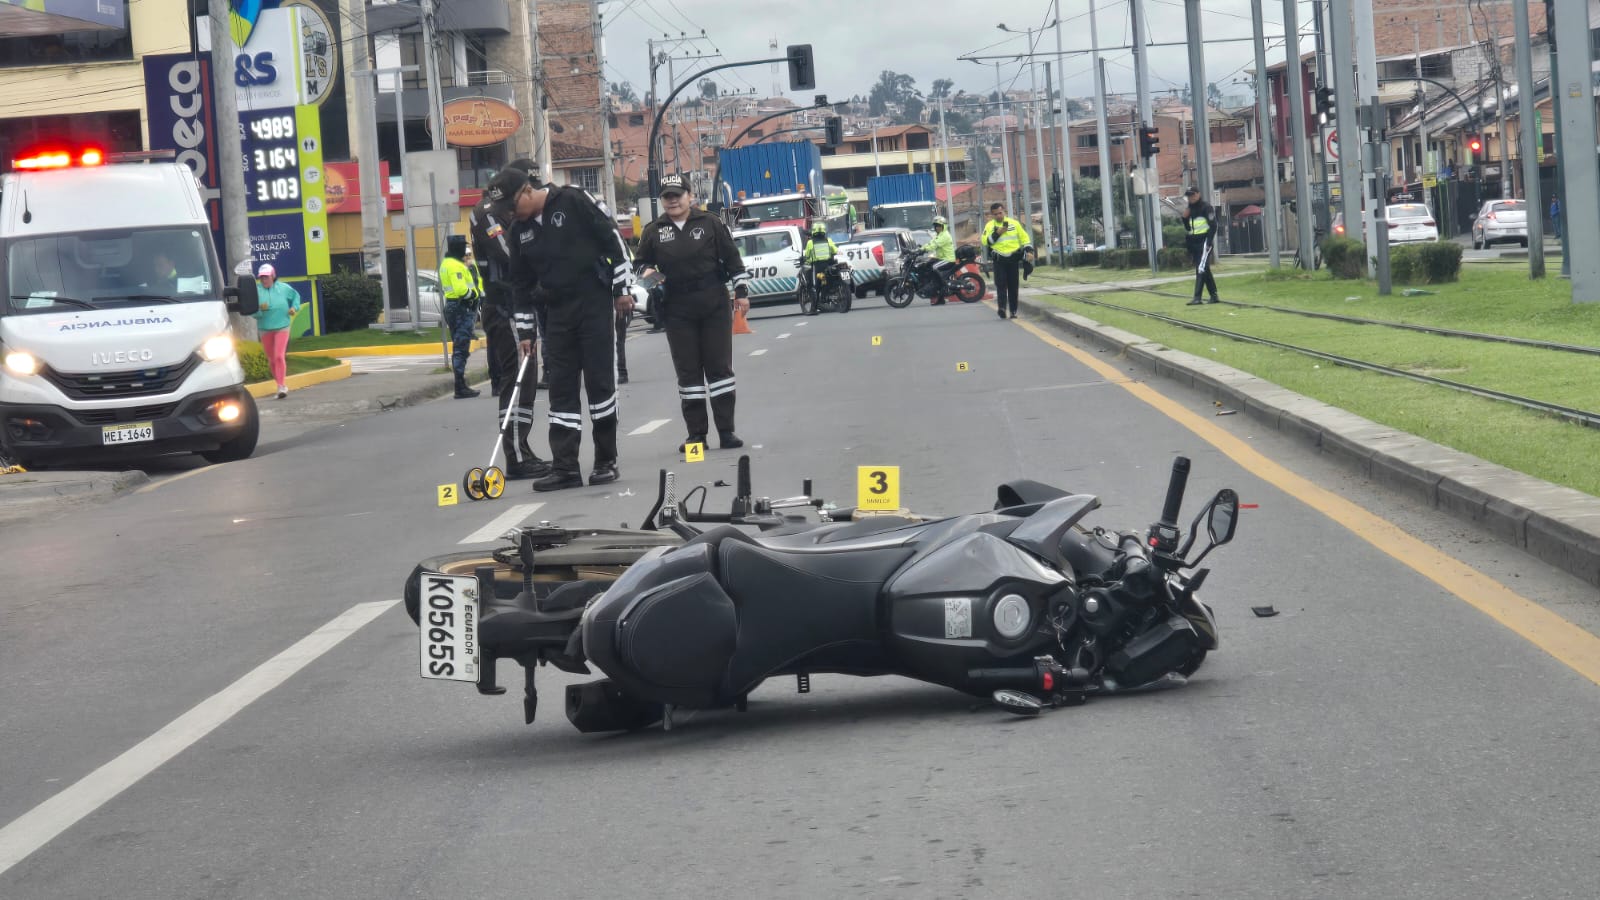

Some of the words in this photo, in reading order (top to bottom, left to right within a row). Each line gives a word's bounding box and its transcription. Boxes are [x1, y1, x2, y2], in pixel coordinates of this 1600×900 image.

[234, 51, 277, 87] &S
[847, 250, 870, 261] 911
[747, 266, 778, 279] SITO
[92, 349, 153, 366] IVECO
[104, 428, 152, 443] MEI-1649
[690, 444, 700, 456] 4
[869, 471, 888, 495] 3
[443, 487, 452, 498] 2
[464, 604, 474, 655] ECUADOR
